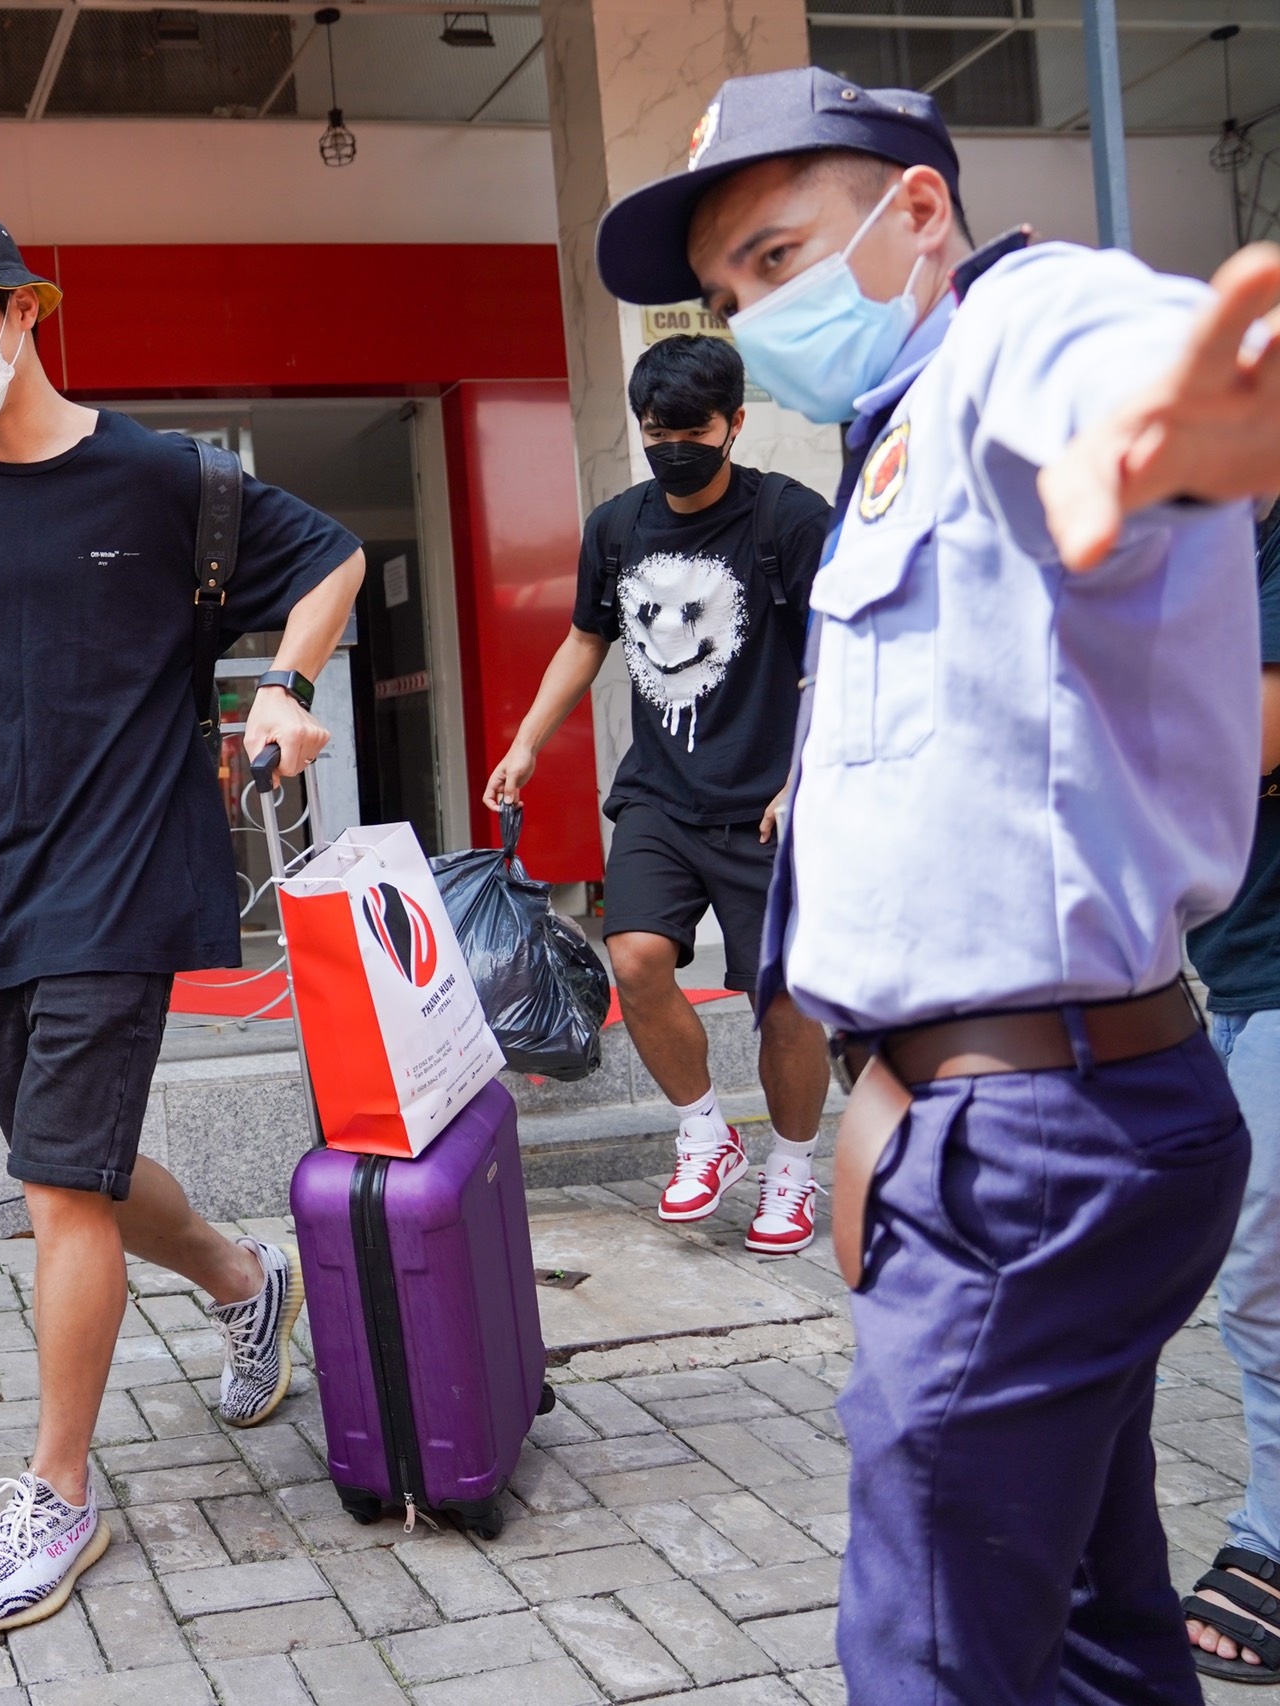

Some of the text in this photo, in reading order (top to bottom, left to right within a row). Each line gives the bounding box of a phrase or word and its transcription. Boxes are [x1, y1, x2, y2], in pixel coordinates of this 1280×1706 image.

[653, 311, 690, 329] CAO
[421, 991, 442, 1018] THANH
[437, 997, 452, 1015] FUTSAL
